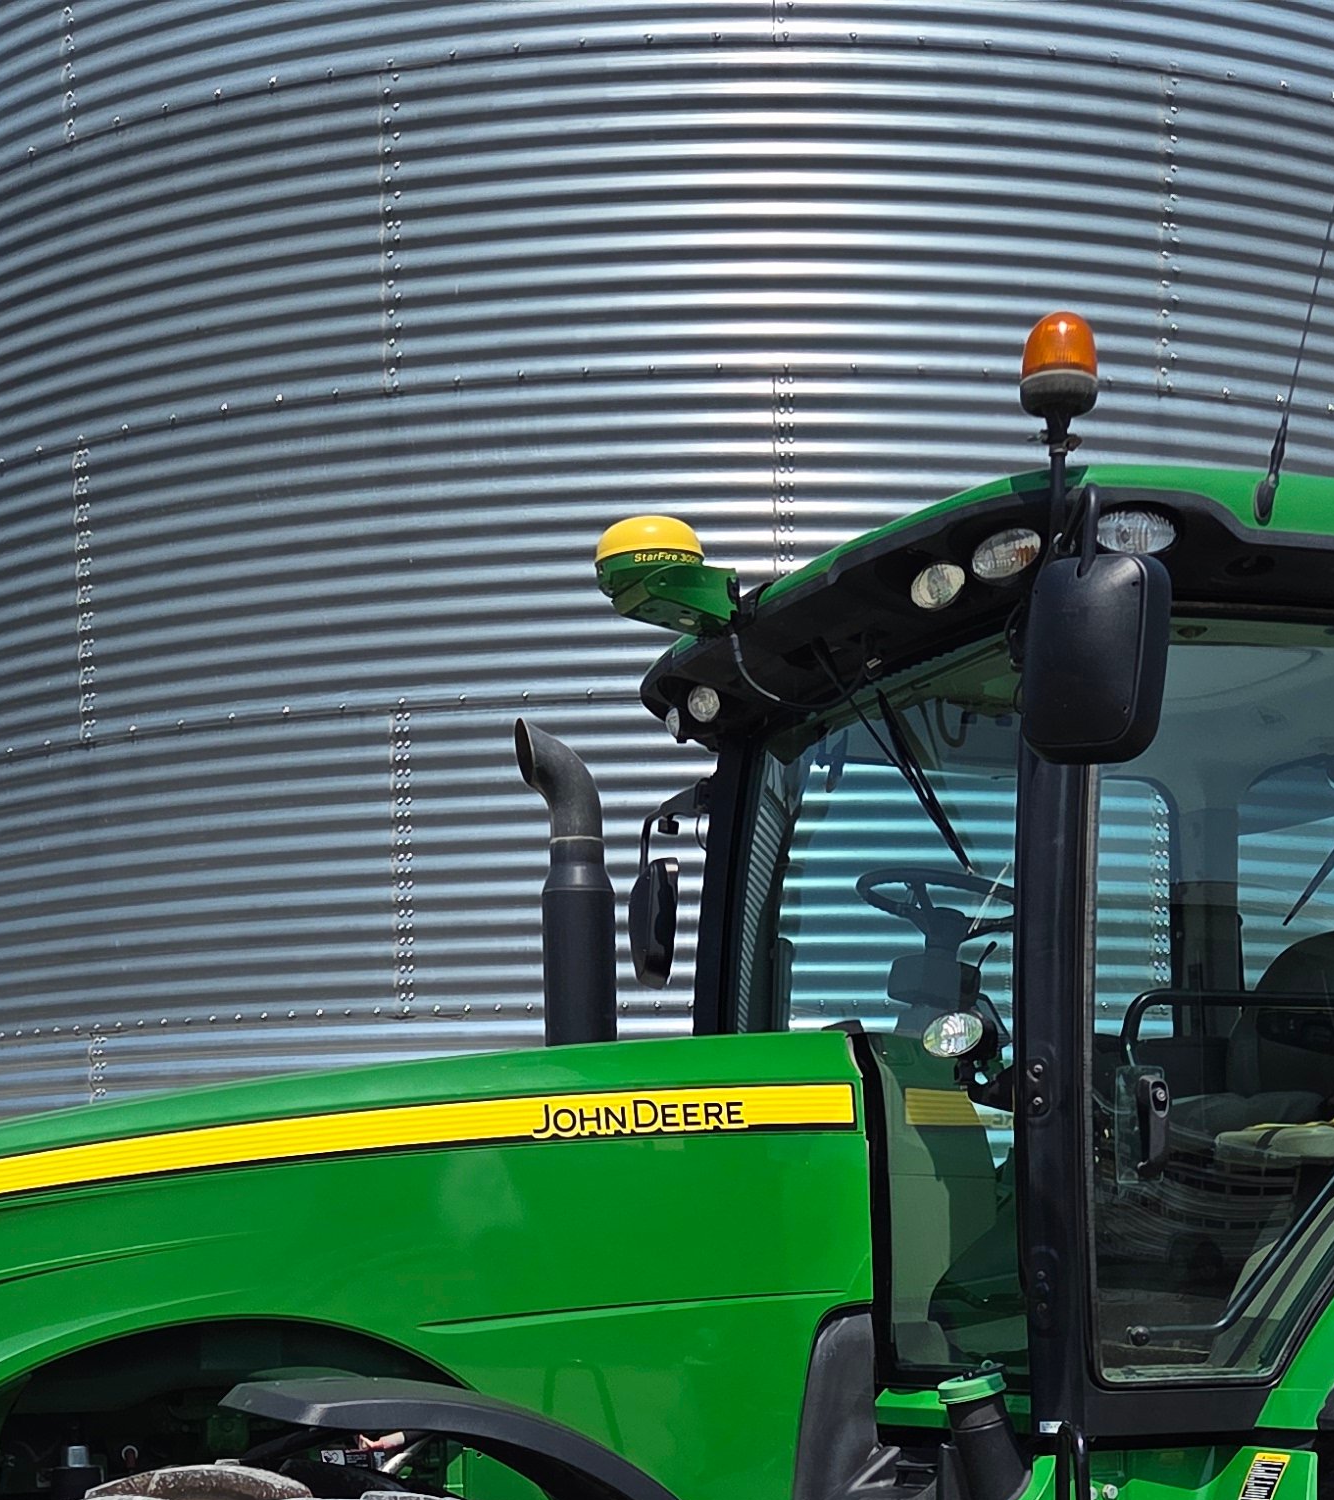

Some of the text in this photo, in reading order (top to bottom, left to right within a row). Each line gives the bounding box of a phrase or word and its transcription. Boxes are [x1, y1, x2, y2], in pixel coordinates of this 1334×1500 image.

[634, 551, 678, 563] StarFire
[533, 1099, 745, 1134] JOHN DEERE
